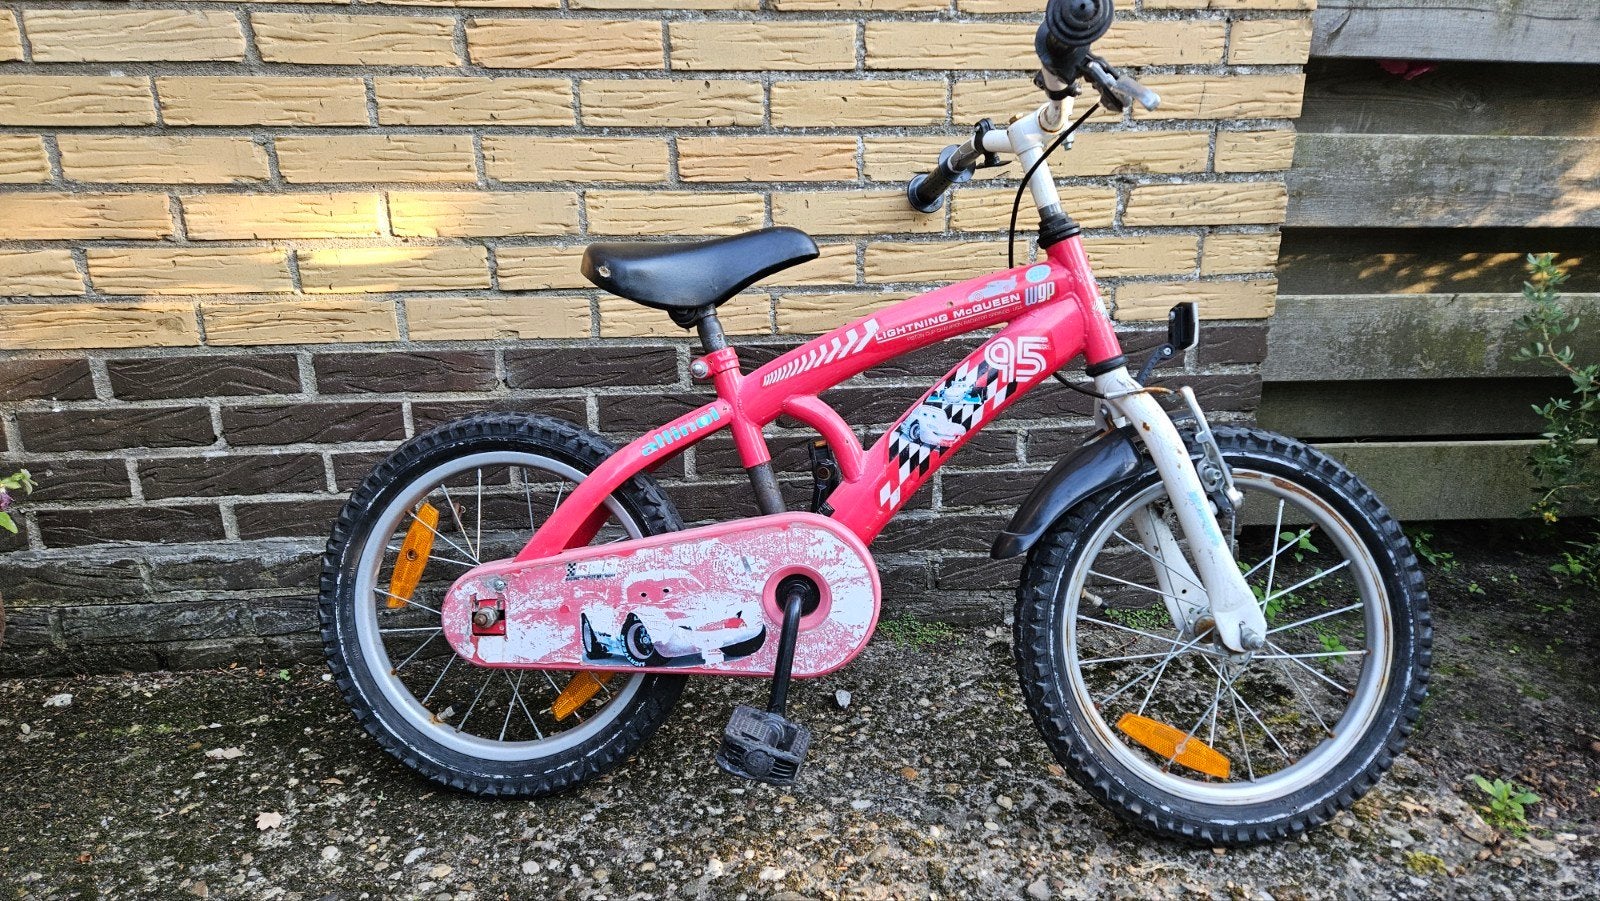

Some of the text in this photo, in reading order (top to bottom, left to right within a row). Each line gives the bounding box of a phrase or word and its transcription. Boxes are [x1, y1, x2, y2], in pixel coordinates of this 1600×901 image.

[875, 293, 1021, 341] LIGHTNING McQUEEN
[984, 336, 1049, 383] 95
[641, 406, 720, 457] allinol
